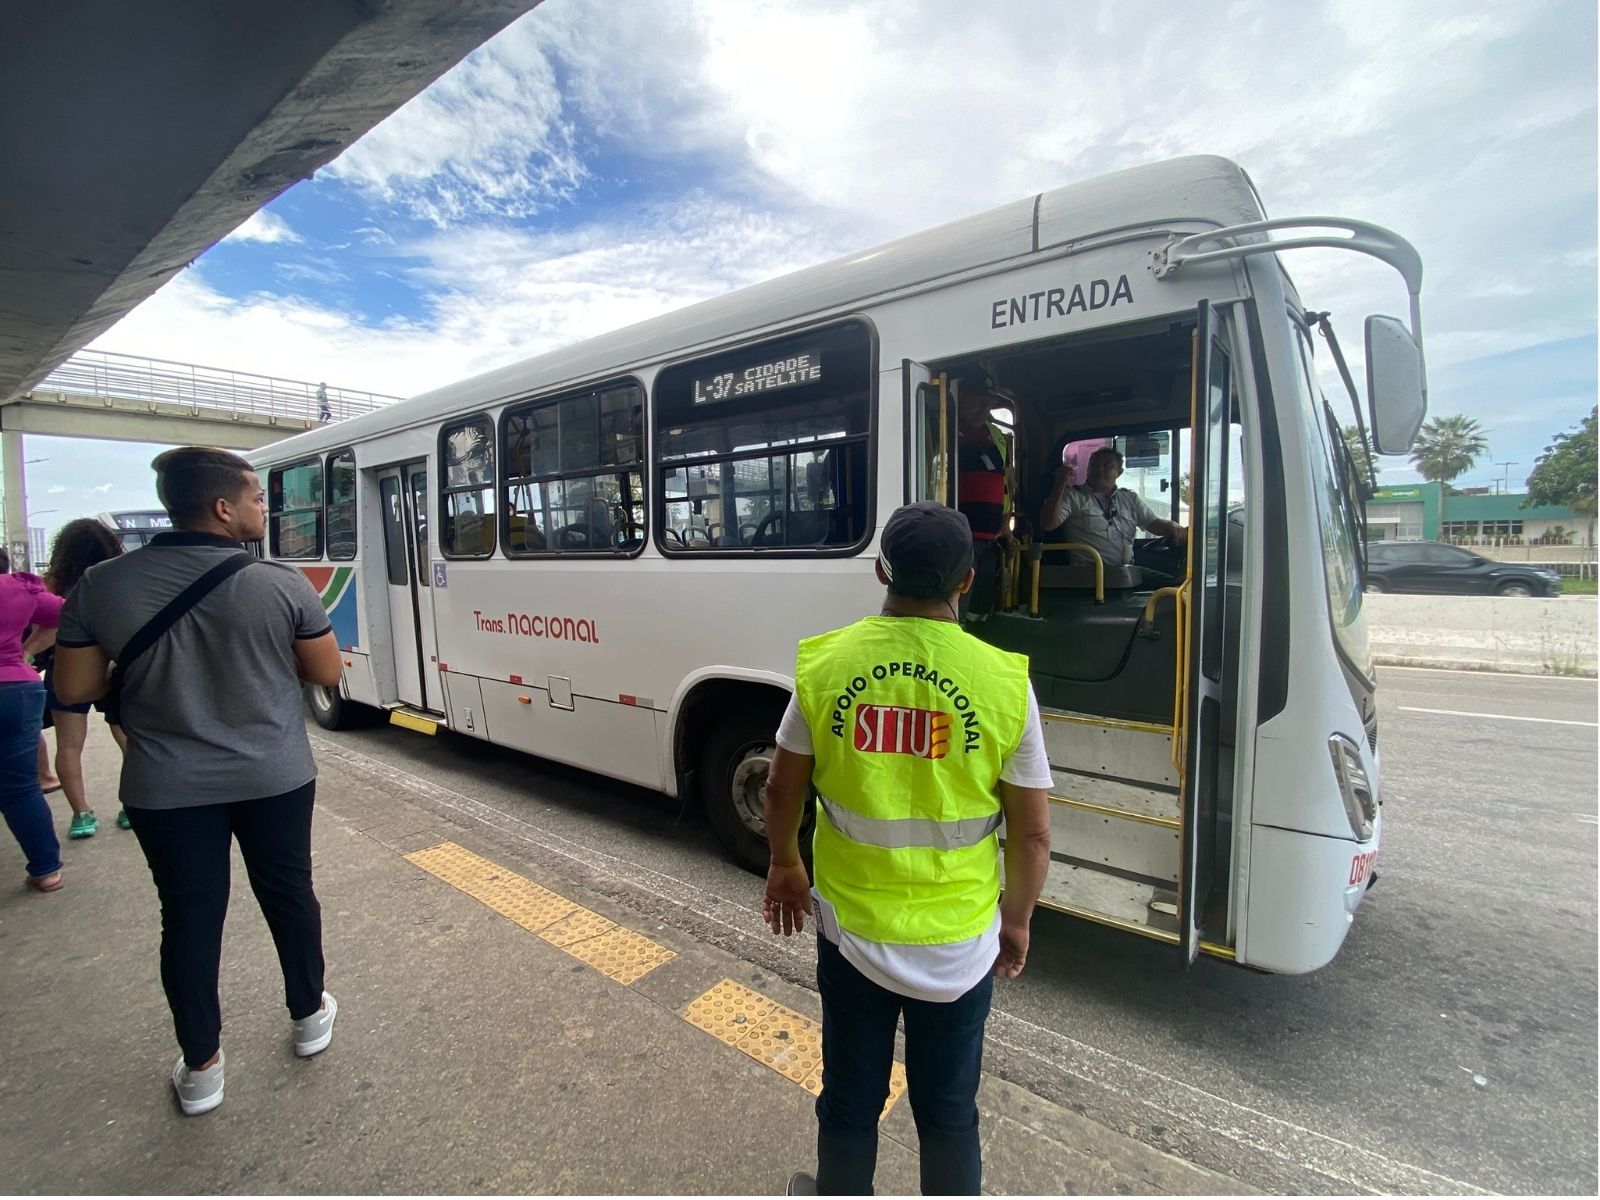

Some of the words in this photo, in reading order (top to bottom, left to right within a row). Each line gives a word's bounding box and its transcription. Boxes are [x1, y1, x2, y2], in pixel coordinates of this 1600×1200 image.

[991, 274, 1134, 329] ENTRADA
[735, 365, 821, 395] SATELITE
[744, 354, 810, 380] CIDADE
[695, 372, 734, 403] L-37
[473, 610, 507, 634] Trans.
[508, 613, 599, 644] nacional
[831, 676, 867, 738] APOIO
[871, 661, 980, 753] OPERACIONAL
[858, 705, 932, 757] STTU
